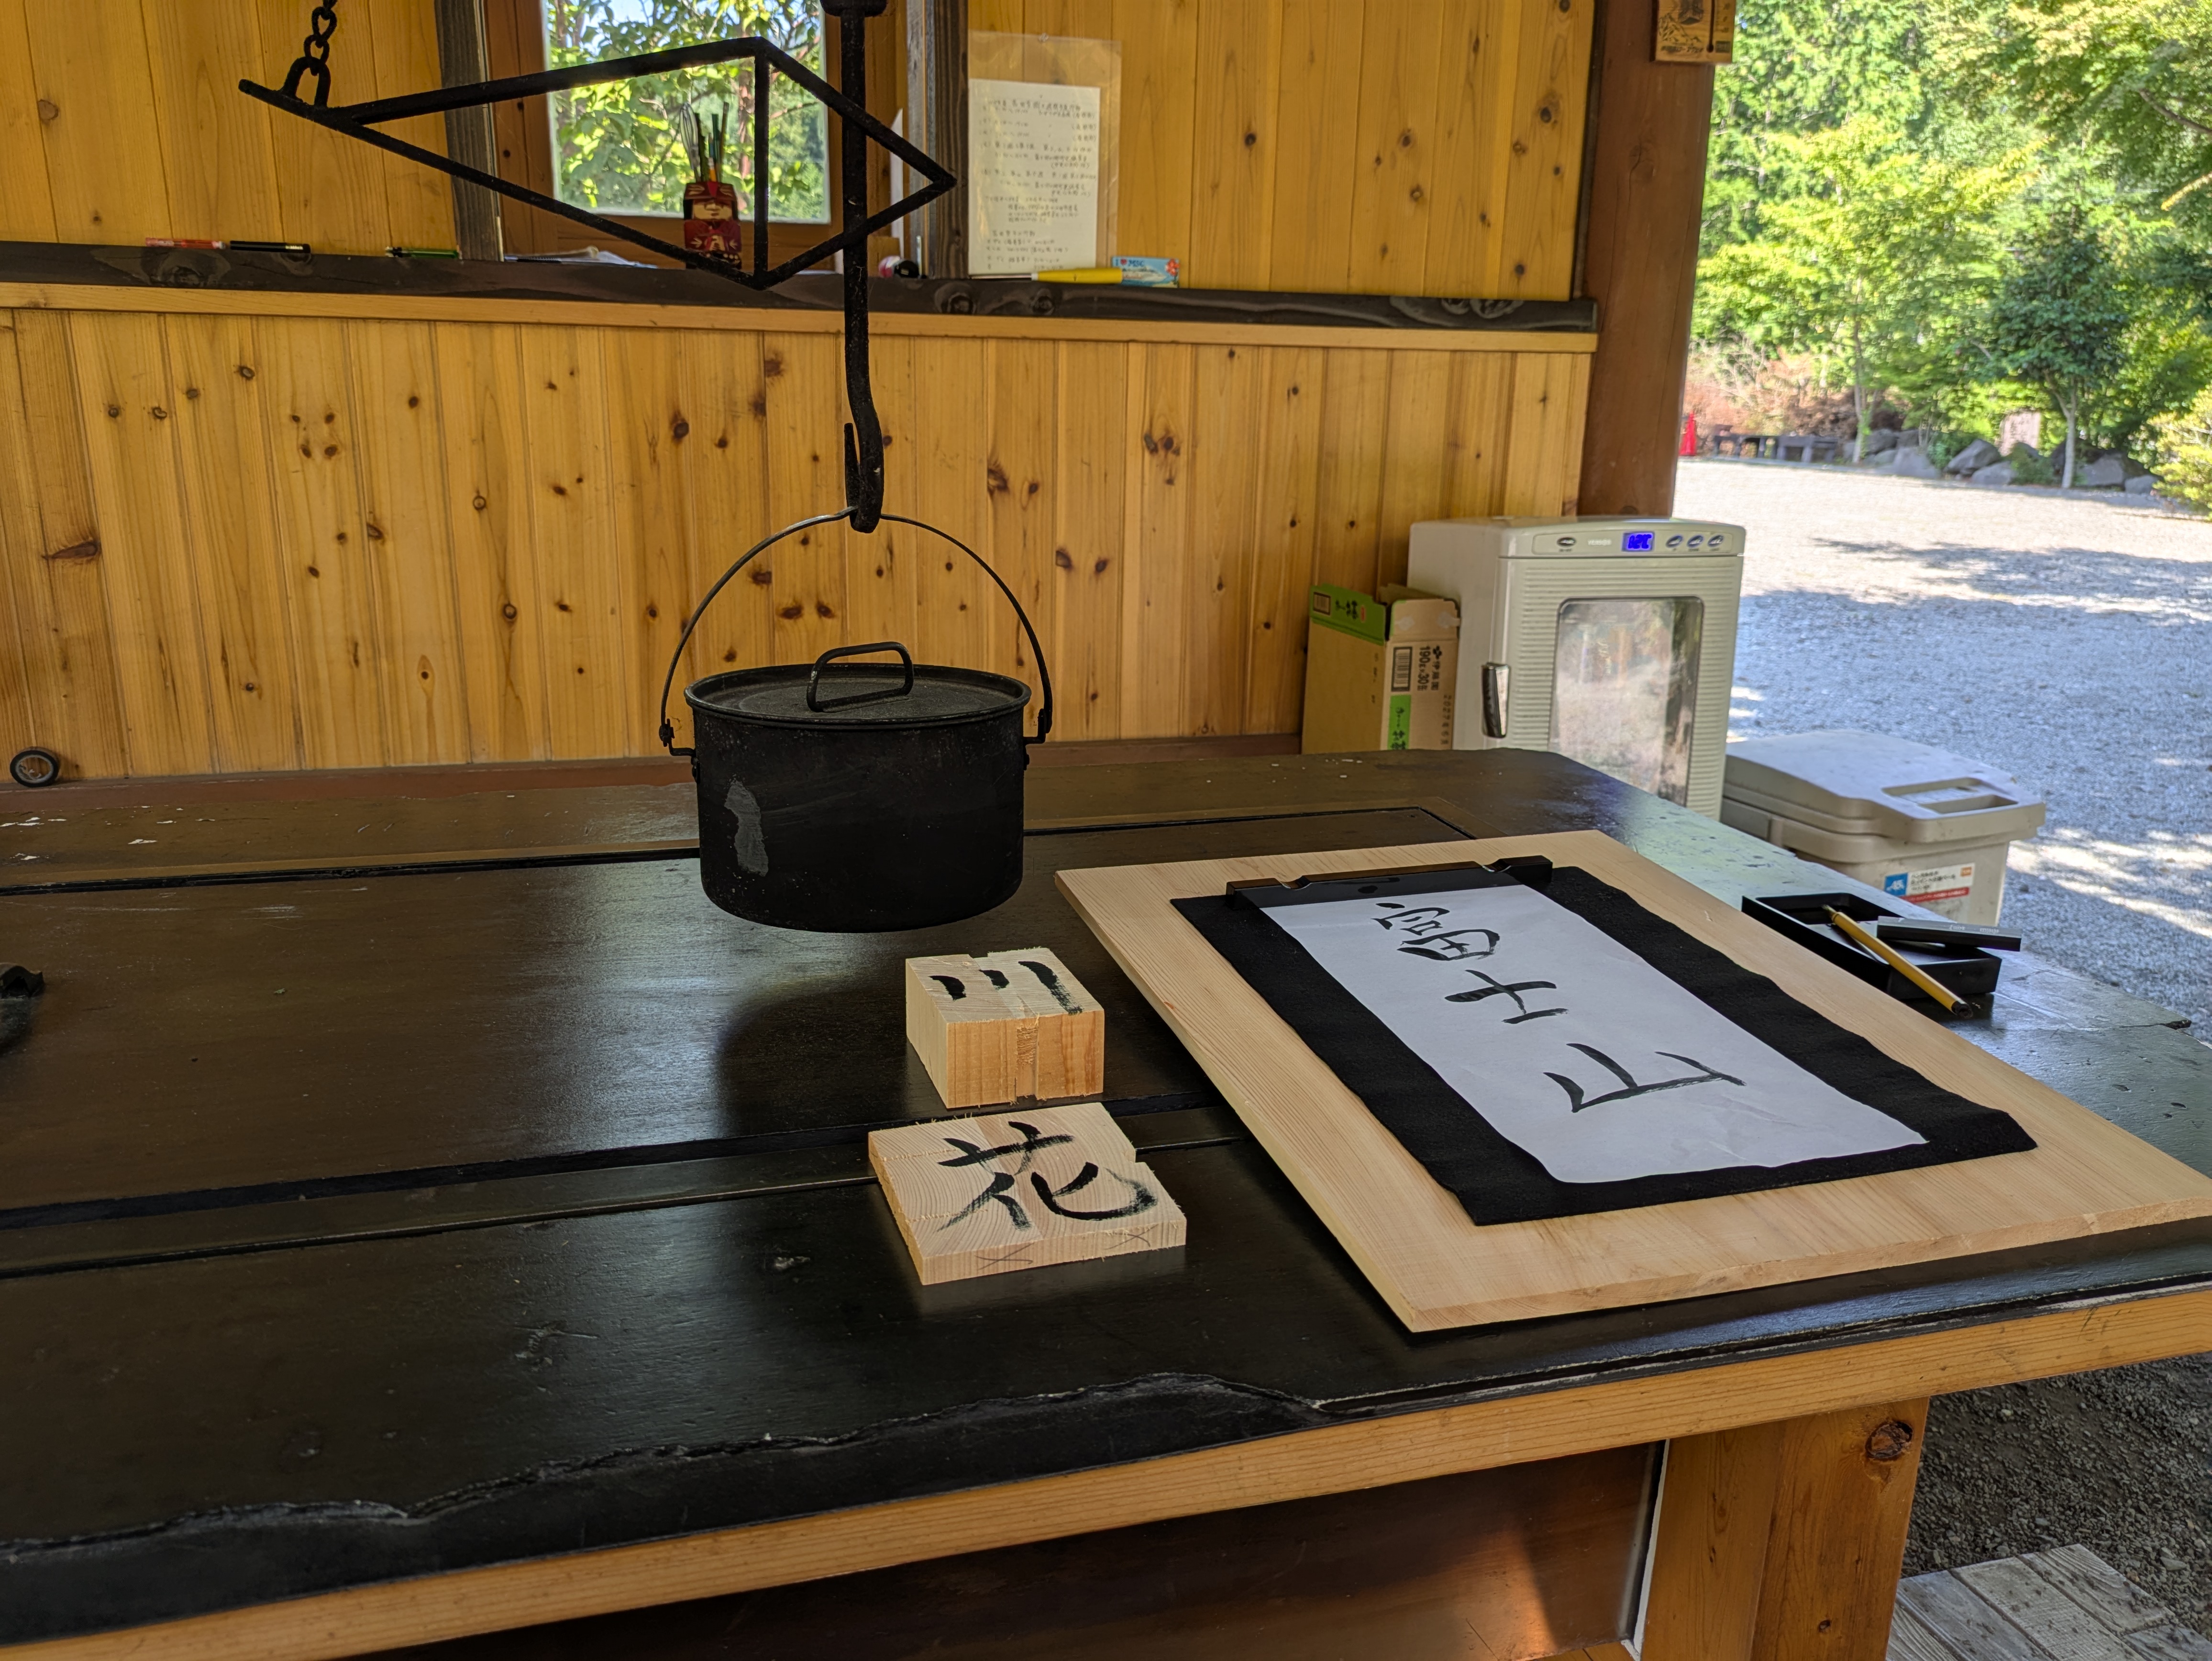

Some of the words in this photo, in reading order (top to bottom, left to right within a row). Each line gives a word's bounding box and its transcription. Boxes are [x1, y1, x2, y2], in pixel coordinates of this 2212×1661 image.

[1371, 902, 1746, 1113] 富士山
[937, 1121, 1158, 1232] 花
